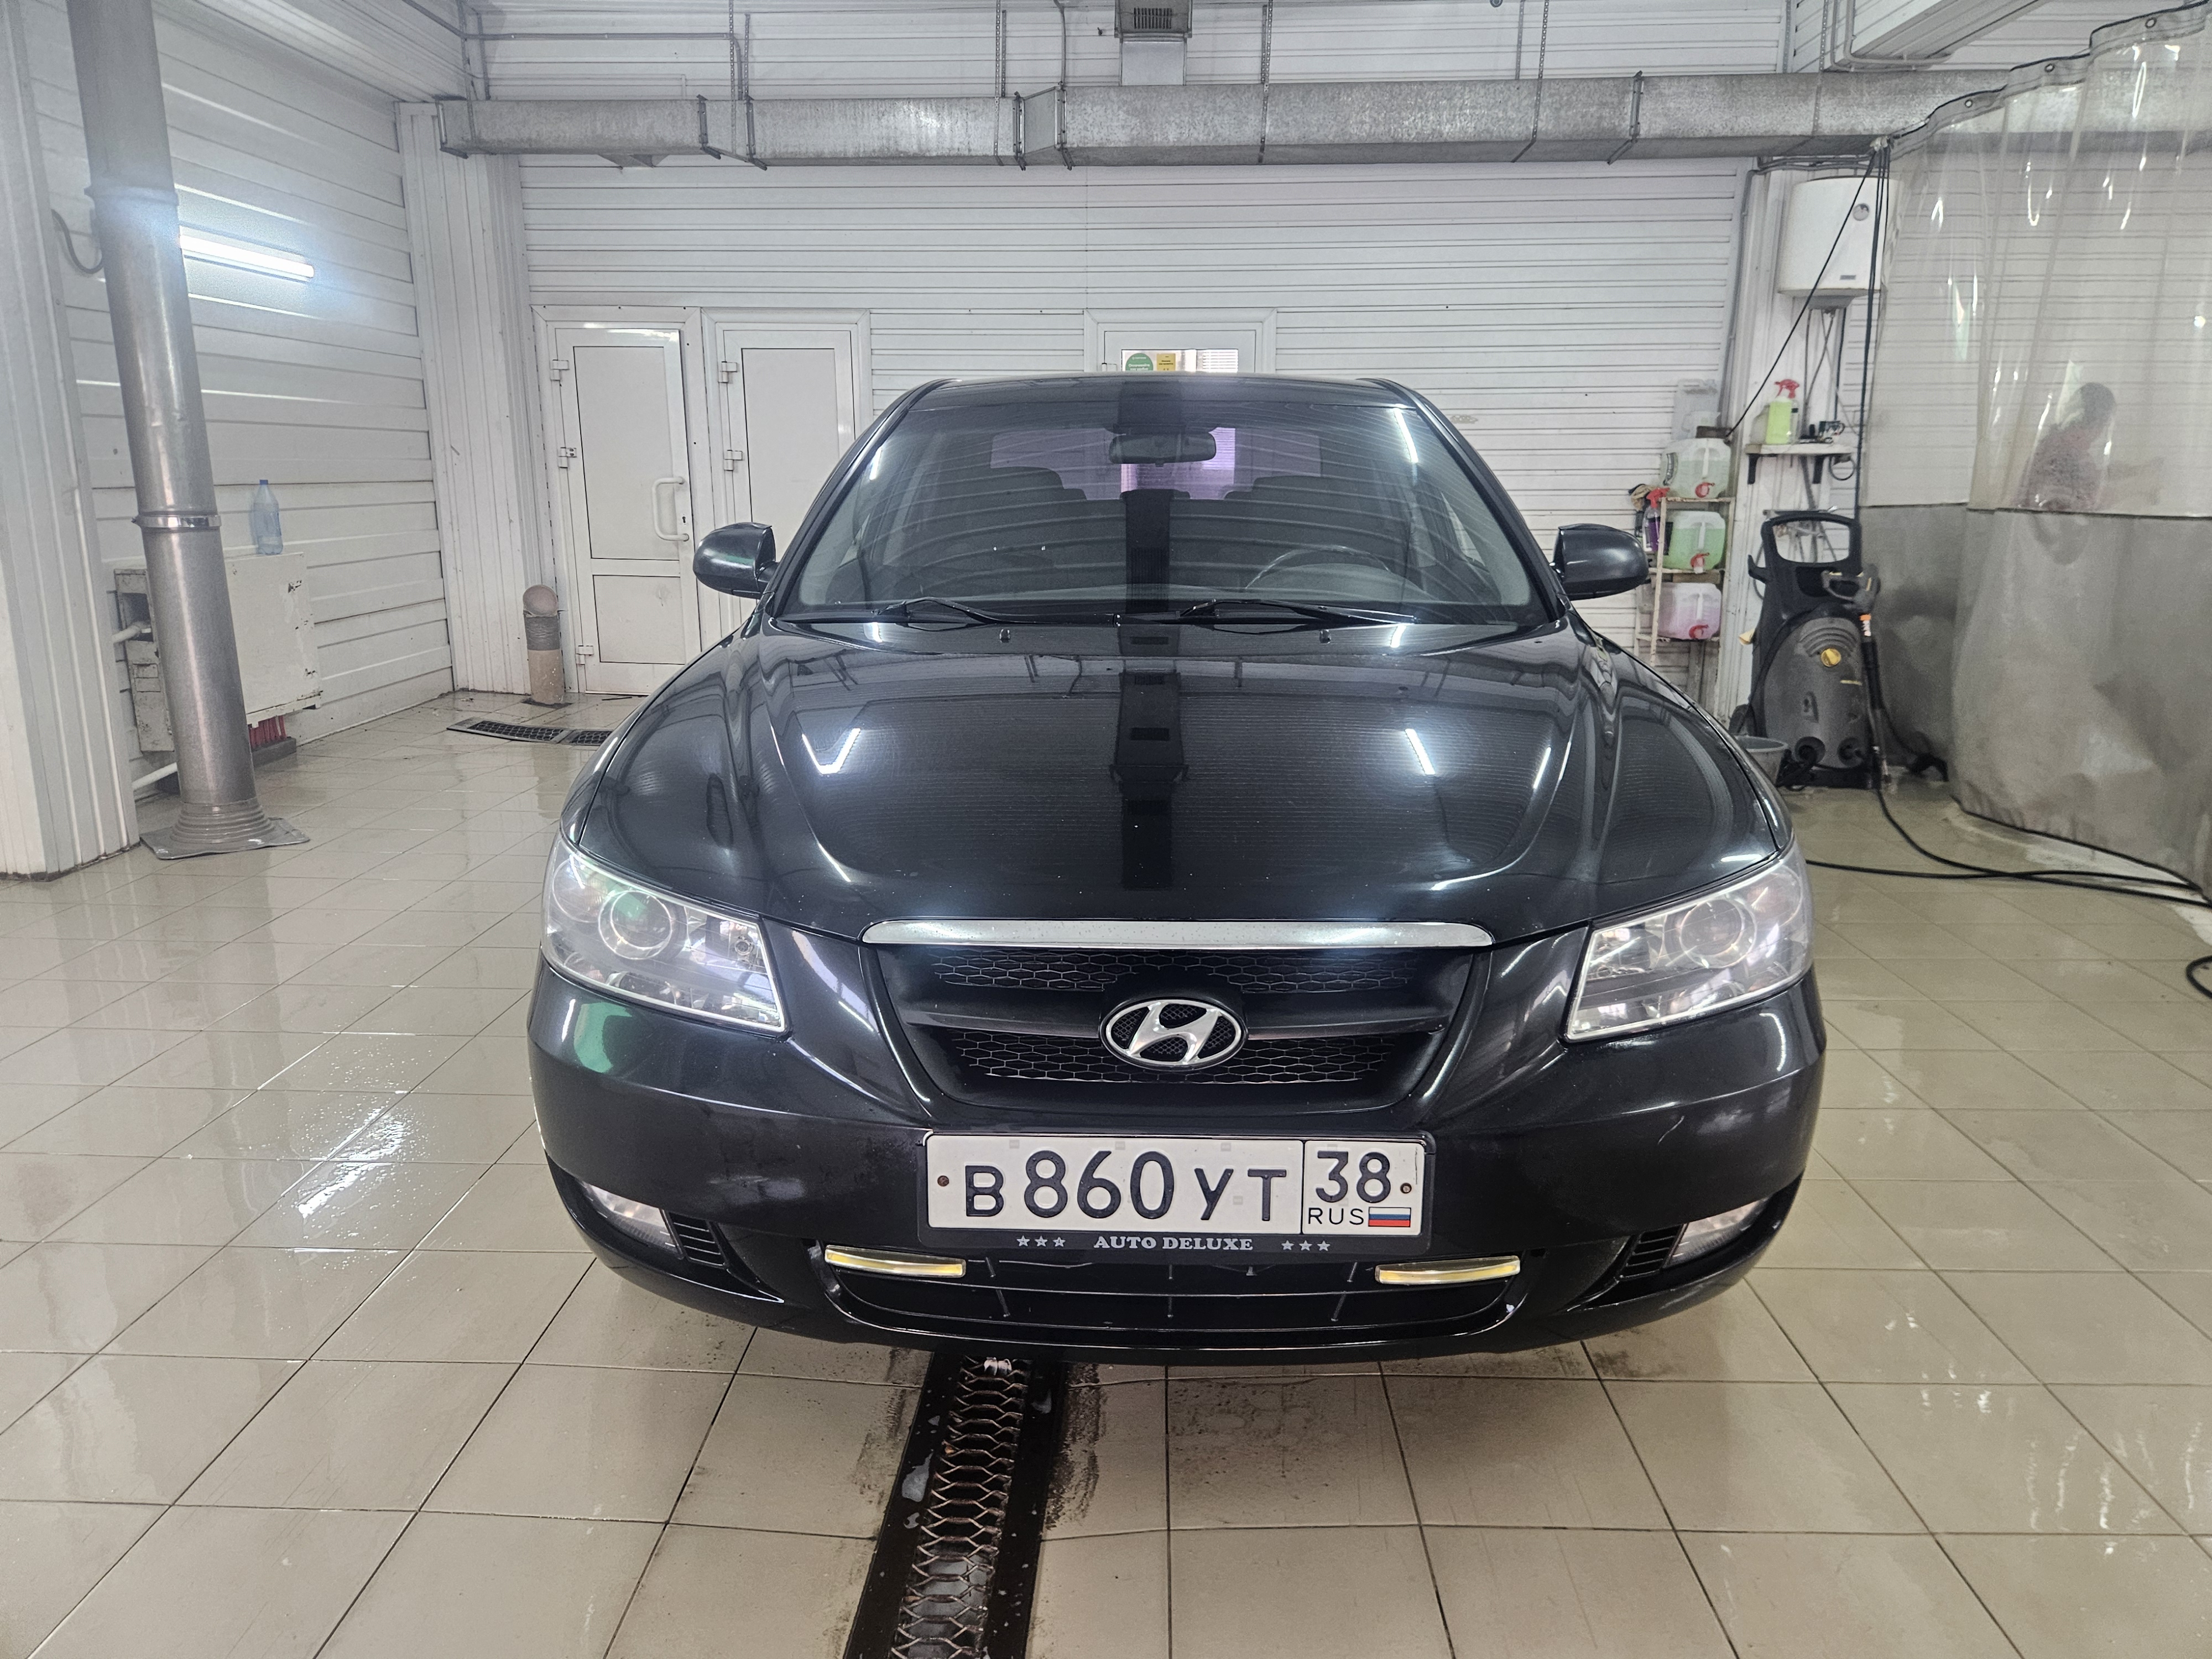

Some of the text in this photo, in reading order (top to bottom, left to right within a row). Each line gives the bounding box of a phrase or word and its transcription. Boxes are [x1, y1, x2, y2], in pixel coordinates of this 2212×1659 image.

[1316, 1150, 1391, 1203] 38
[1308, 1207, 1364, 1225] RUS
[1094, 1236, 1254, 1251] AUTO DELUXE
